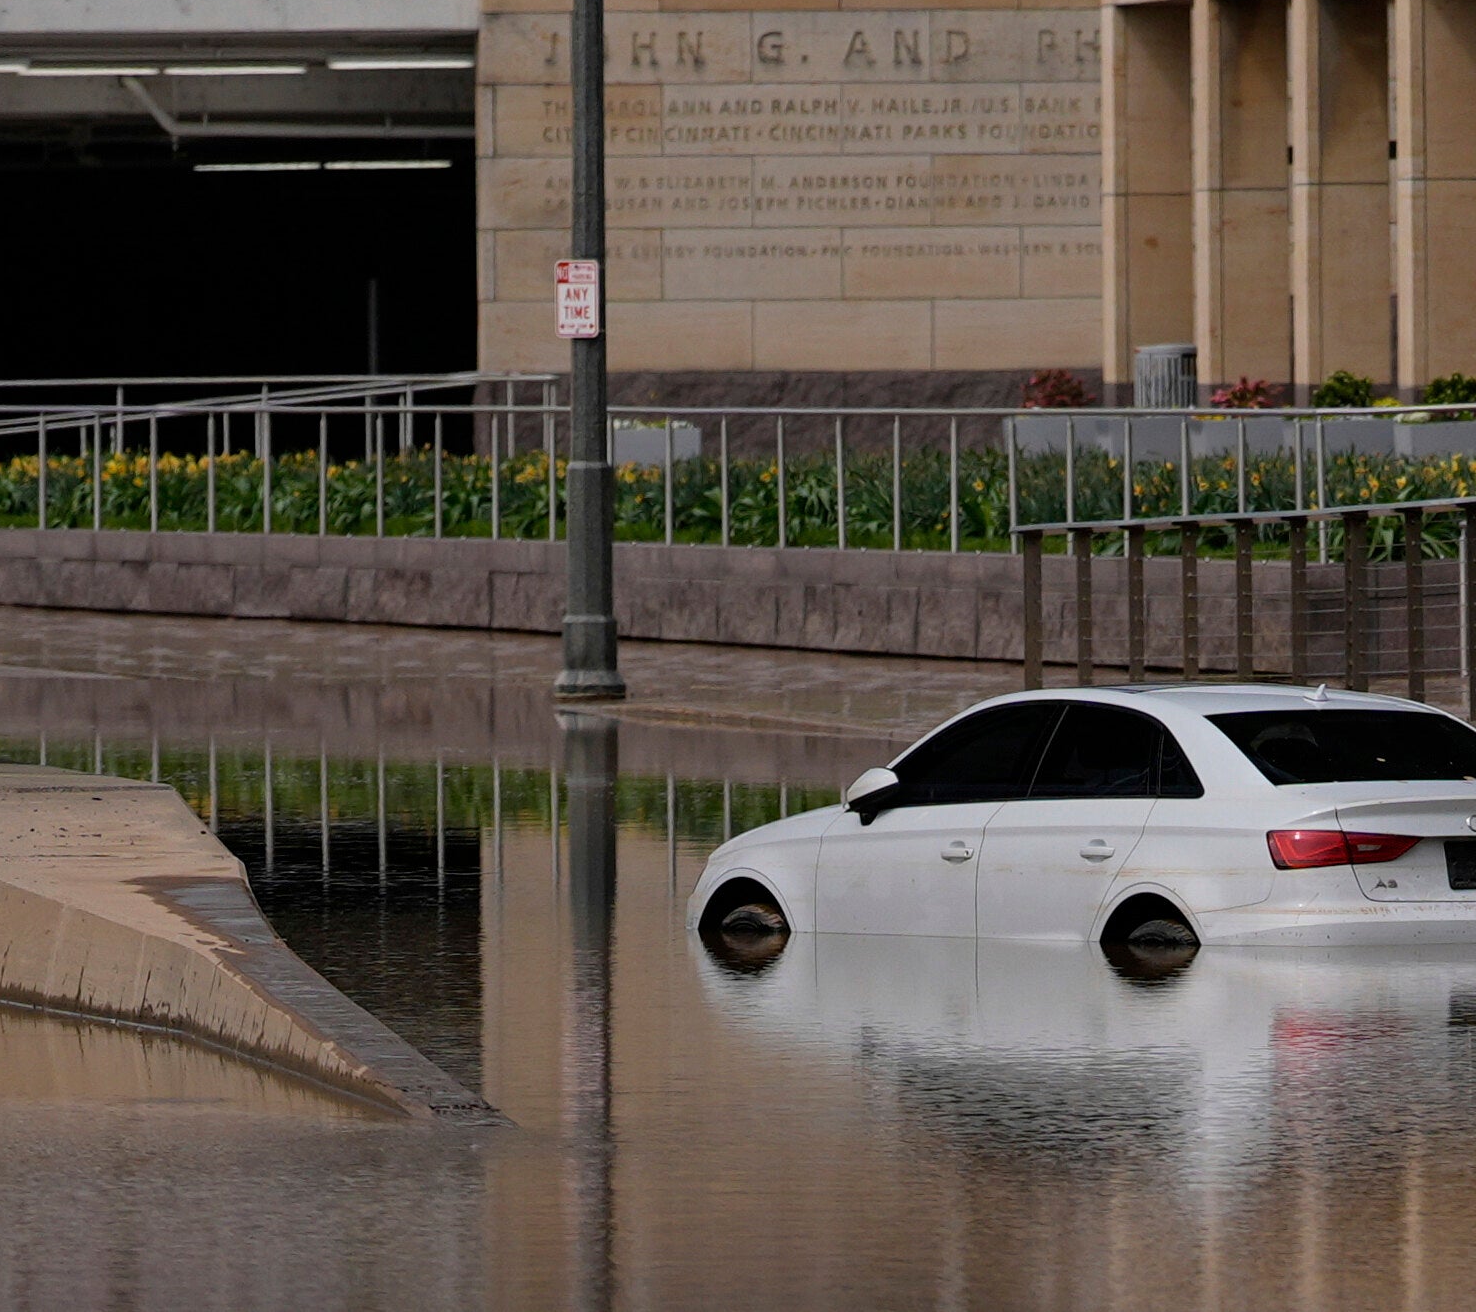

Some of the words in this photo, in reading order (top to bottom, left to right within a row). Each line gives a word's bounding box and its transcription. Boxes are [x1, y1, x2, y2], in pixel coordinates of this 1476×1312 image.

[543, 31, 706, 68] JHN
[757, 31, 809, 66] G.
[842, 29, 972, 67] AND
[605, 99, 659, 117] AROL
[719, 99, 763, 115] AND
[770, 97, 839, 115] RALPH
[542, 126, 572, 143] CIT
[626, 125, 750, 143] CINCINNATI
[769, 124, 892, 143] CINCINNATI
[902, 124, 967, 140] PARKS
[977, 123, 1101, 140] FOUNDATIO
[788, 175, 888, 190] ANDERSON
[564, 287, 589, 301] ANY
[564, 305, 591, 320] TIME
